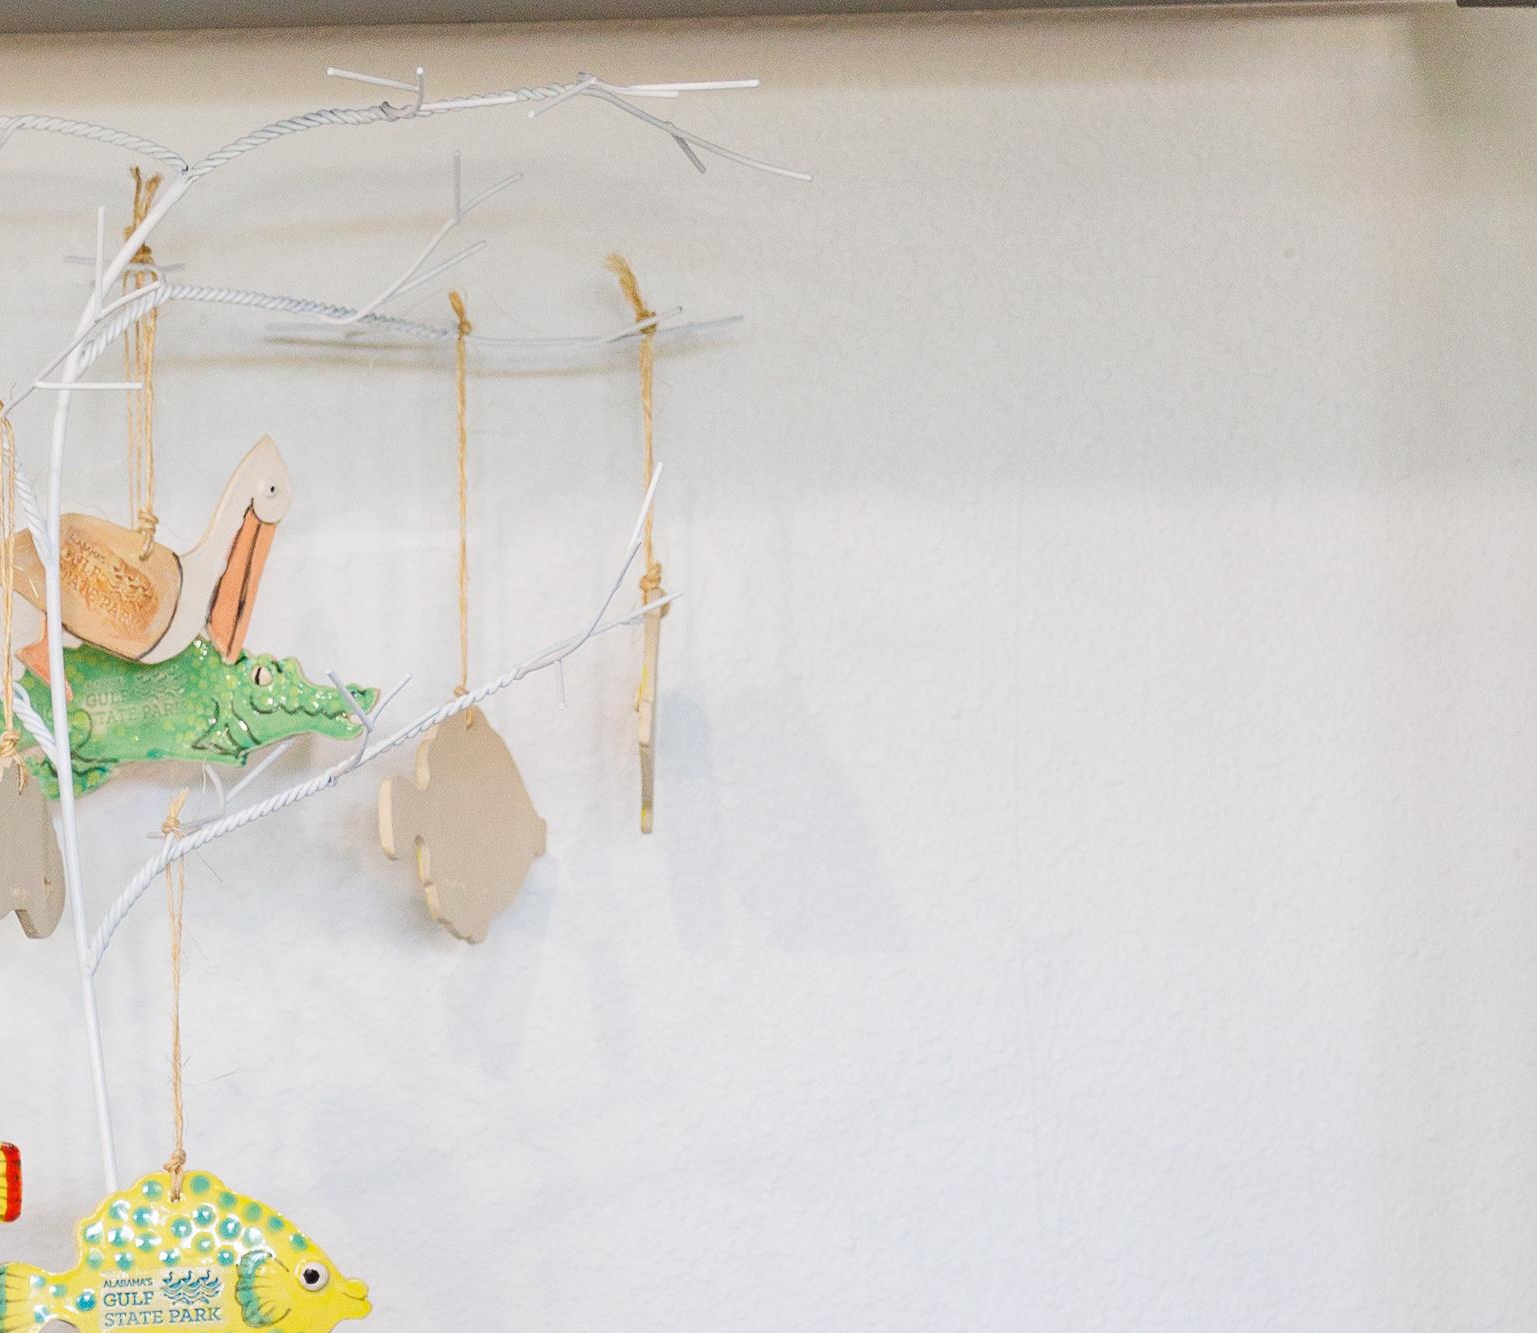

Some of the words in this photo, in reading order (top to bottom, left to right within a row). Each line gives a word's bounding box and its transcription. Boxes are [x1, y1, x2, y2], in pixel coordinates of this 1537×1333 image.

[103, 1291, 154, 1307] GULF
[104, 1310, 163, 1327] STATE
[169, 1307, 221, 1323] PARK
